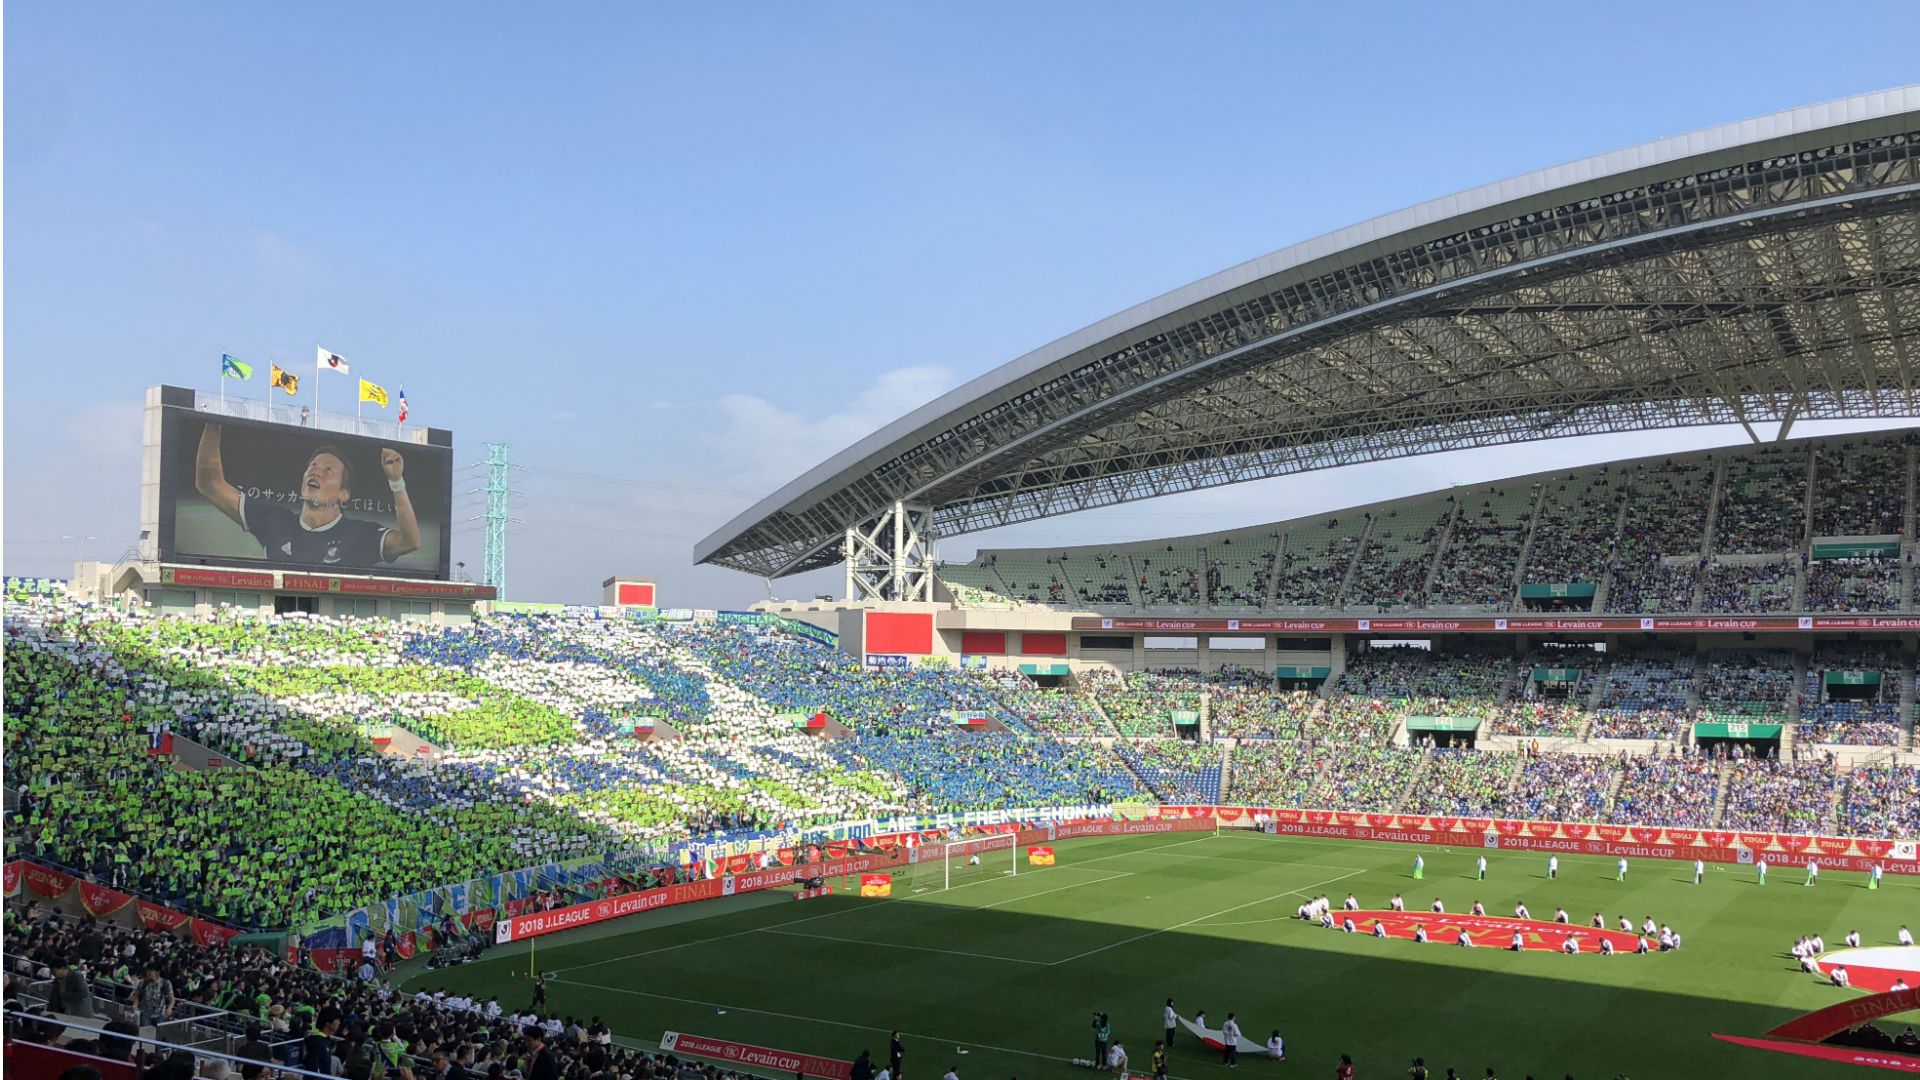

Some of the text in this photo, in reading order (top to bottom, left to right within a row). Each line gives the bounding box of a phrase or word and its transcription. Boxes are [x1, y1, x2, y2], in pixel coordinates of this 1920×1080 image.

[231, 576, 263, 586] Levain
[293, 580, 325, 589] FINAL
[1156, 620, 1181, 628] Levain
[1417, 620, 1443, 629] Levain
[1558, 620, 1585, 628] Levain
[1708, 619, 1738, 628] Levain
[1873, 618, 1906, 627] Levain
[964, 808, 1036, 826] FRENTE
[1040, 804, 1112, 821] SHONAN
[1058, 828, 1072, 837] 2018
[1073, 825, 1103, 835] J.LEAGUE
[1123, 822, 1154, 833] Levain
[1155, 822, 1172, 831] CUP
[1282, 824, 1304, 832] 2018
[1305, 825, 1348, 835] J.LEAGUE
[1371, 830, 1409, 841] Levain
[1411, 834, 1430, 842] CUP
[1436, 834, 1478, 845] FINAL
[1744, 836, 1768, 844] FINAL
[1820, 841, 1846, 849] FINAL
[922, 849, 938, 858] 2018
[1504, 838, 1528, 847] 2018
[1530, 839, 1579, 850] J.LEAGUE
[1606, 843, 1649, 856] Levain
[1651, 847, 1675, 857] CUP
[1681, 847, 1729, 860] FINAL
[1761, 853, 1790, 863] 2018
[1792, 855, 1848, 867] J.LEAGUE
[1881, 861, 1920, 874] Levai
[741, 874, 762, 888] 2018
[764, 868, 802, 885] J.LEAGUE
[853, 860, 869, 870] CUP
[518, 918, 543, 934] 2018
[546, 908, 590, 928] J.LEAGUE
[613, 895, 647, 914] Levain
[648, 893, 667, 905] CUP
[674, 882, 715, 900] FINAL
[1437, 918, 1531, 931] Levain
[1851, 992, 1910, 1017] FINAL
[680, 1040, 696, 1048] 2018
[696, 1043, 722, 1053] J.LEAGUE
[740, 1048, 778, 1066] Levain
[779, 1057, 800, 1069] CUP
[803, 1060, 844, 1077] FINAL
[1854, 1056, 1901, 1066] 2018
